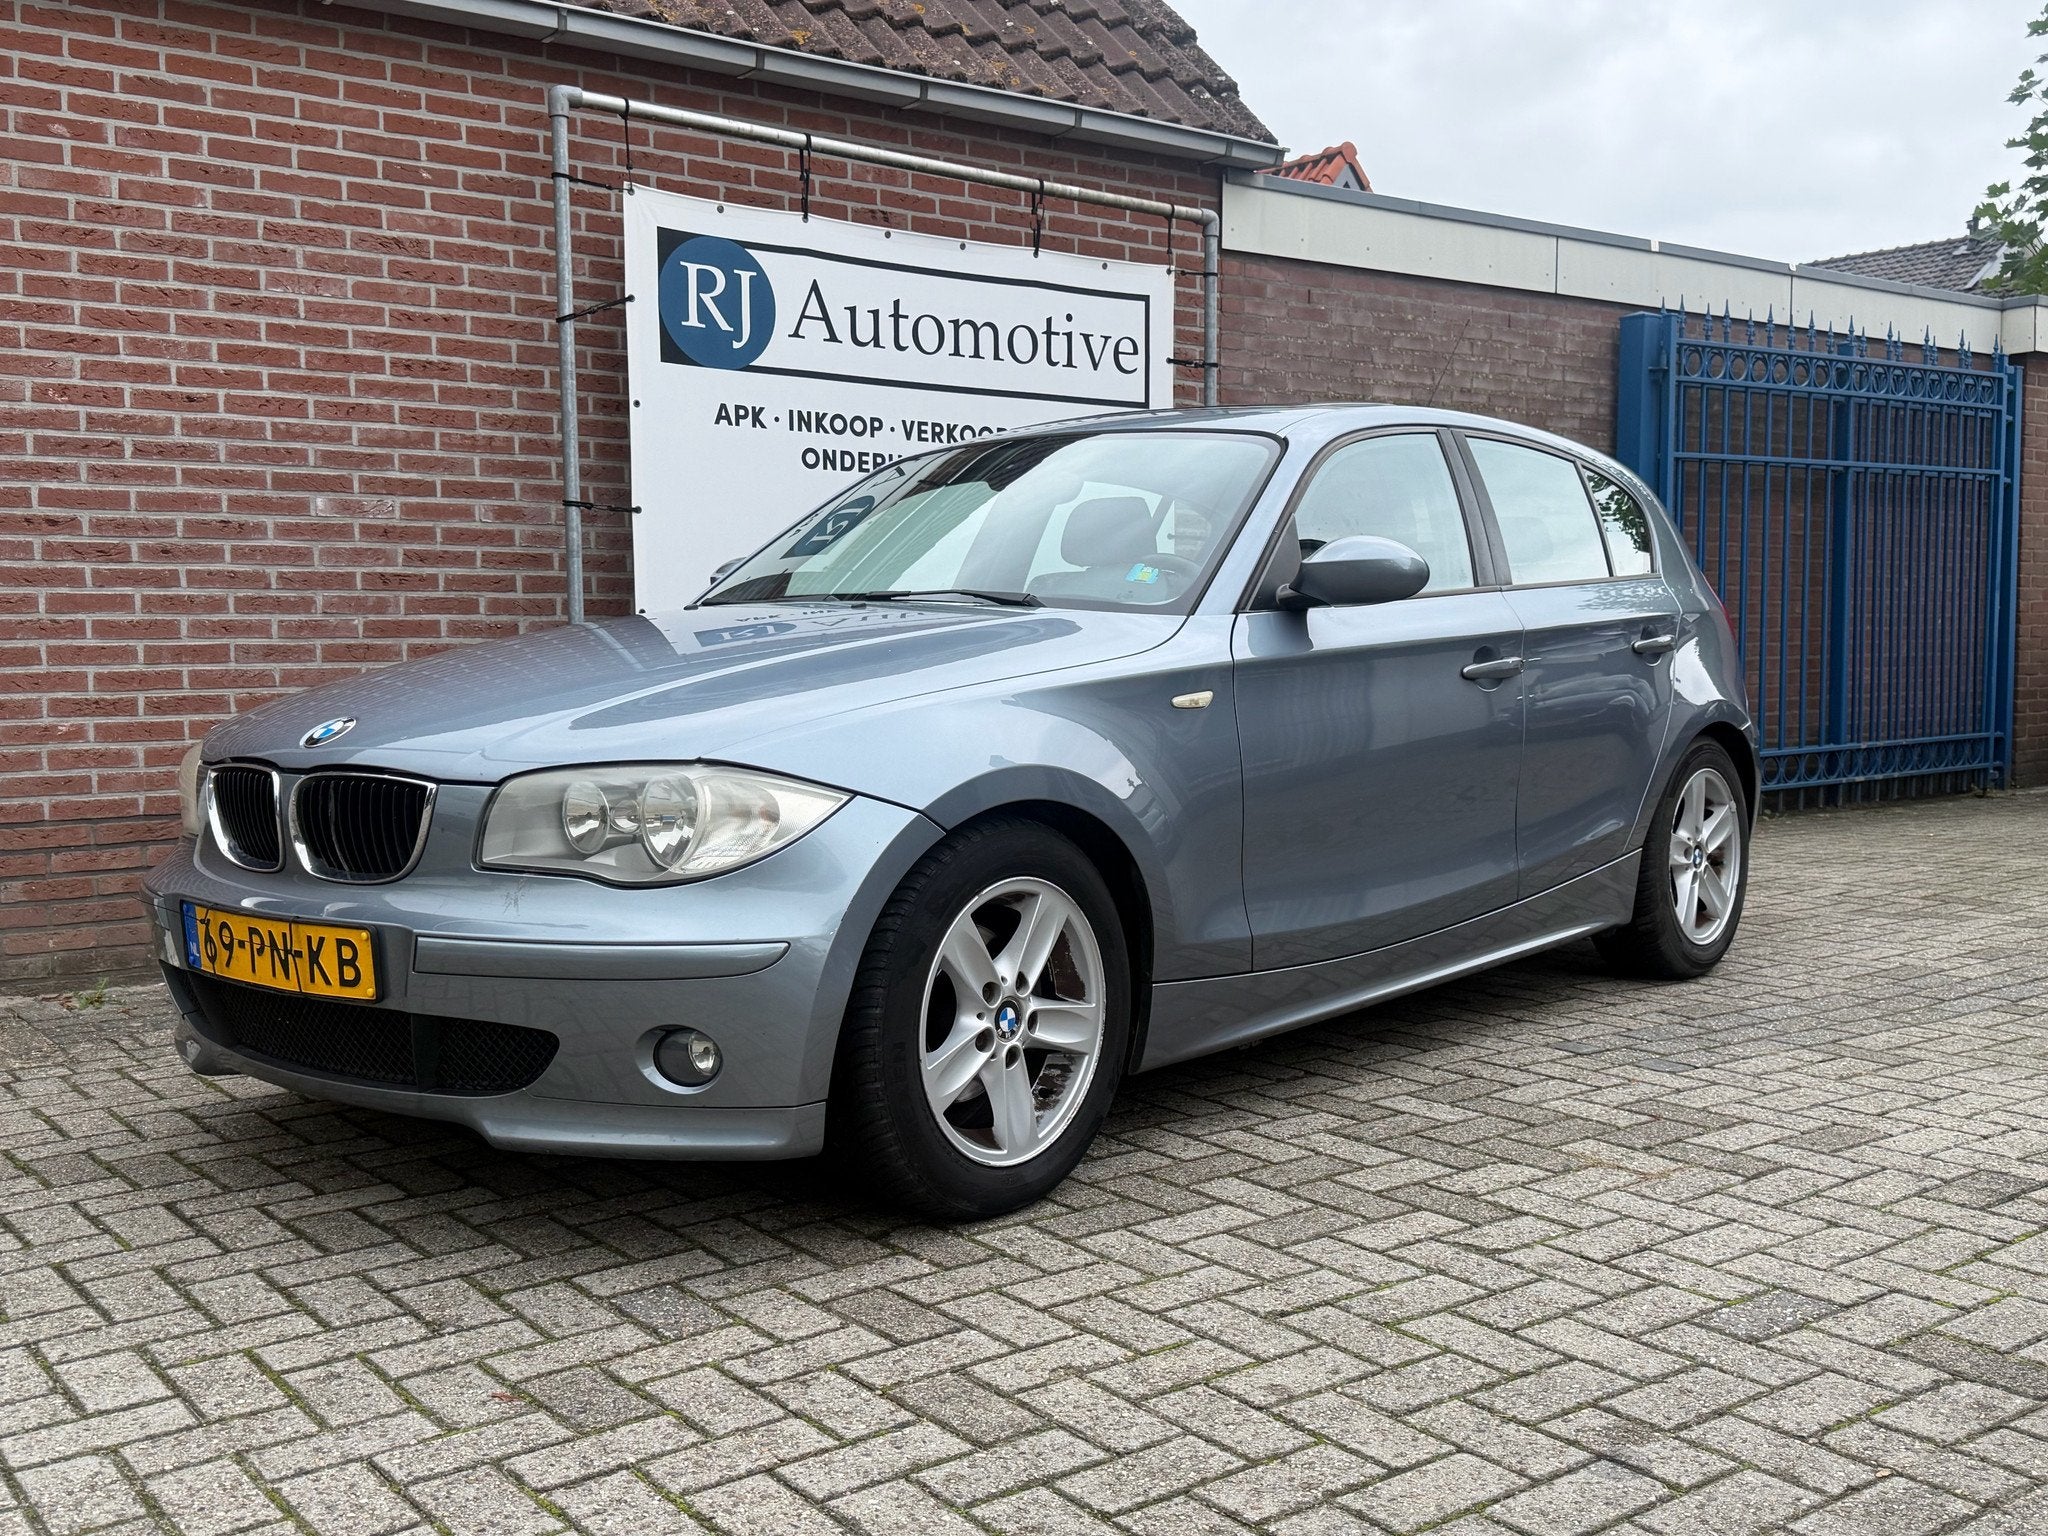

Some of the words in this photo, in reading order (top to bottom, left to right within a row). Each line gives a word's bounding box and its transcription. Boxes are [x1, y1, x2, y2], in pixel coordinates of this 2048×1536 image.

[680, 261, 757, 349] RJ
[788, 278, 1139, 375] Automotive
[714, 403, 767, 429] APK
[788, 409, 884, 438] INKOOP
[203, 918, 362, 988] 69-PN-KB
